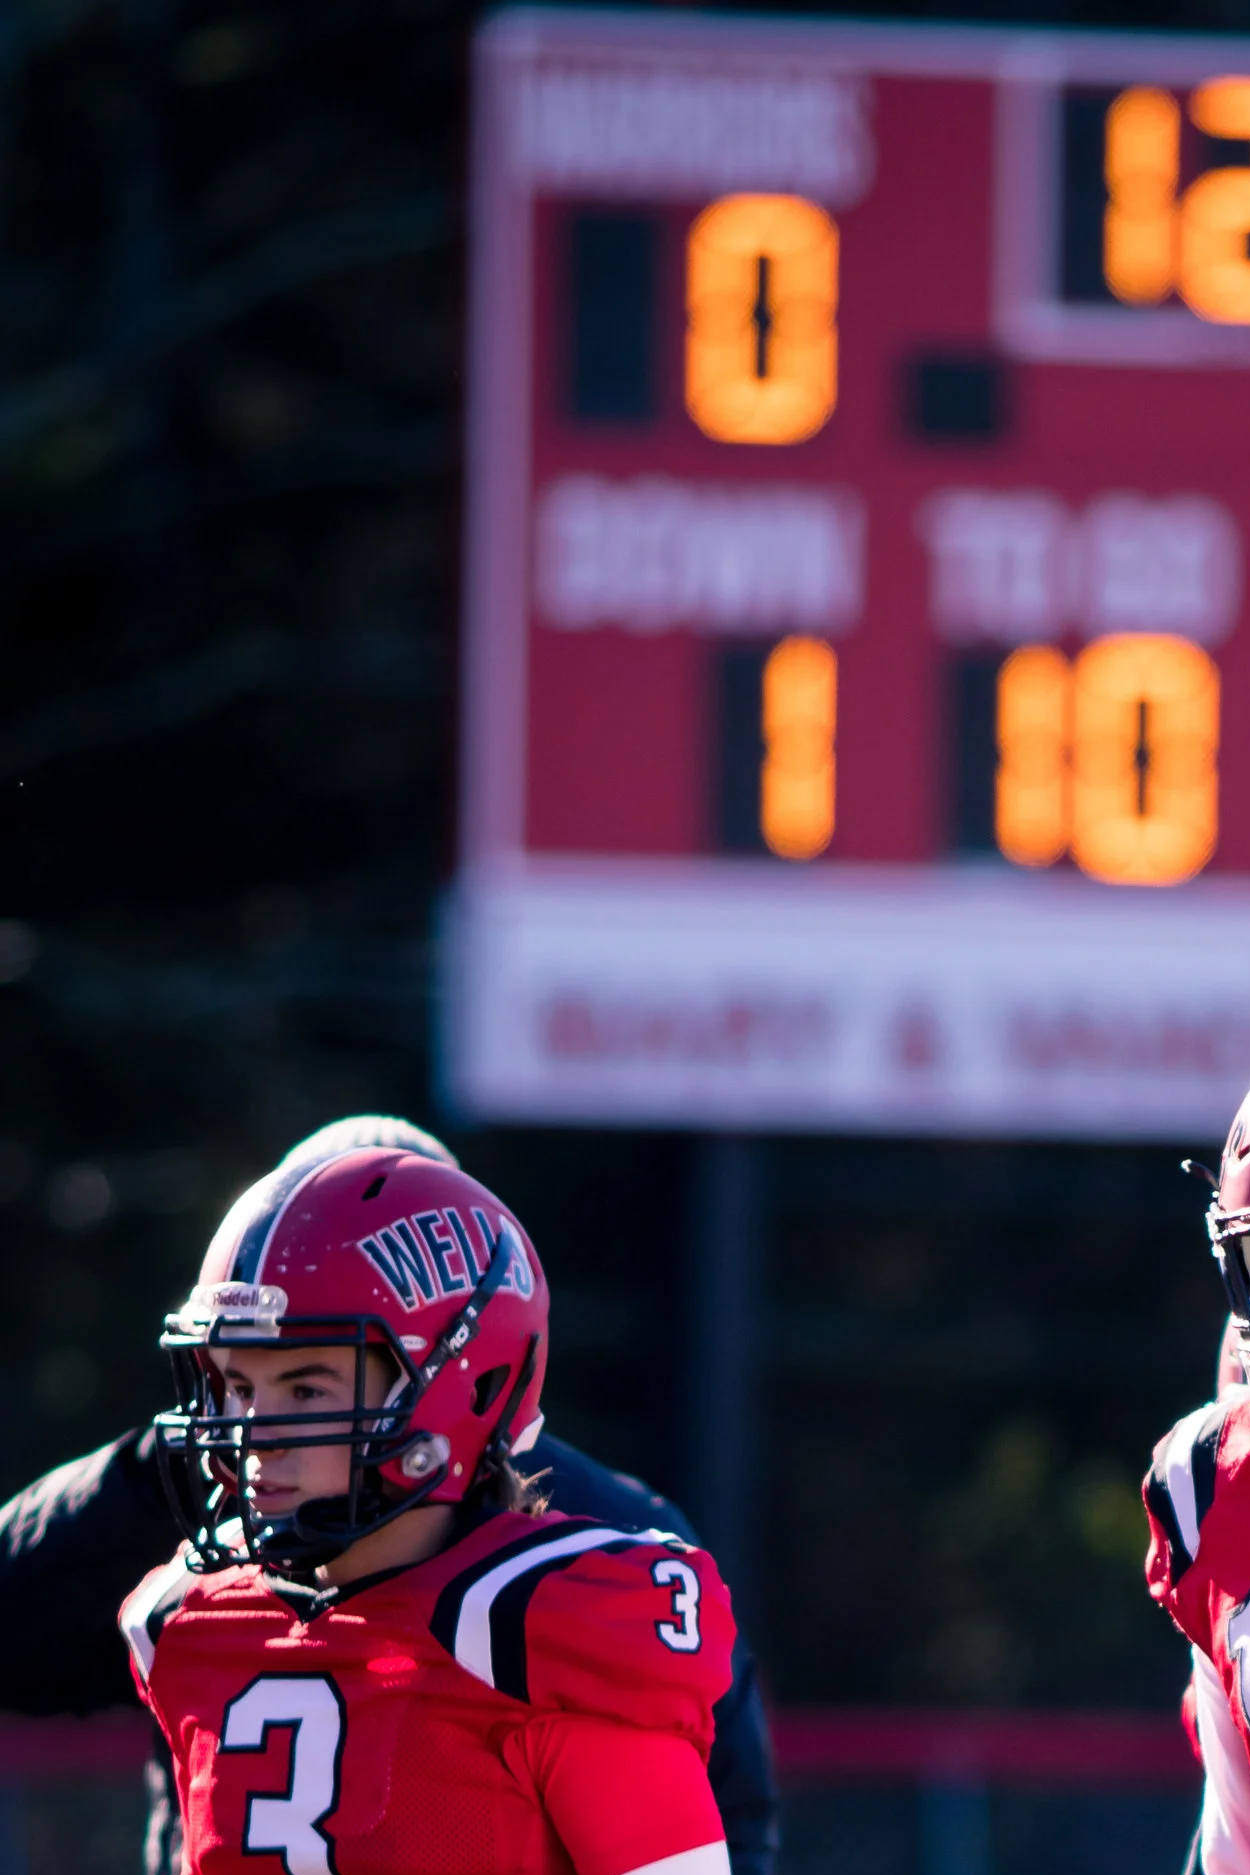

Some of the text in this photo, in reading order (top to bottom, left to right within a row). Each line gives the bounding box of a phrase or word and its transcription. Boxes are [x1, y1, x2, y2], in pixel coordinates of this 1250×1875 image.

[685, 191, 840, 446] 0
[762, 636, 839, 860] 1
[994, 633, 1222, 886] 10
[649, 1558, 703, 1655] 3
